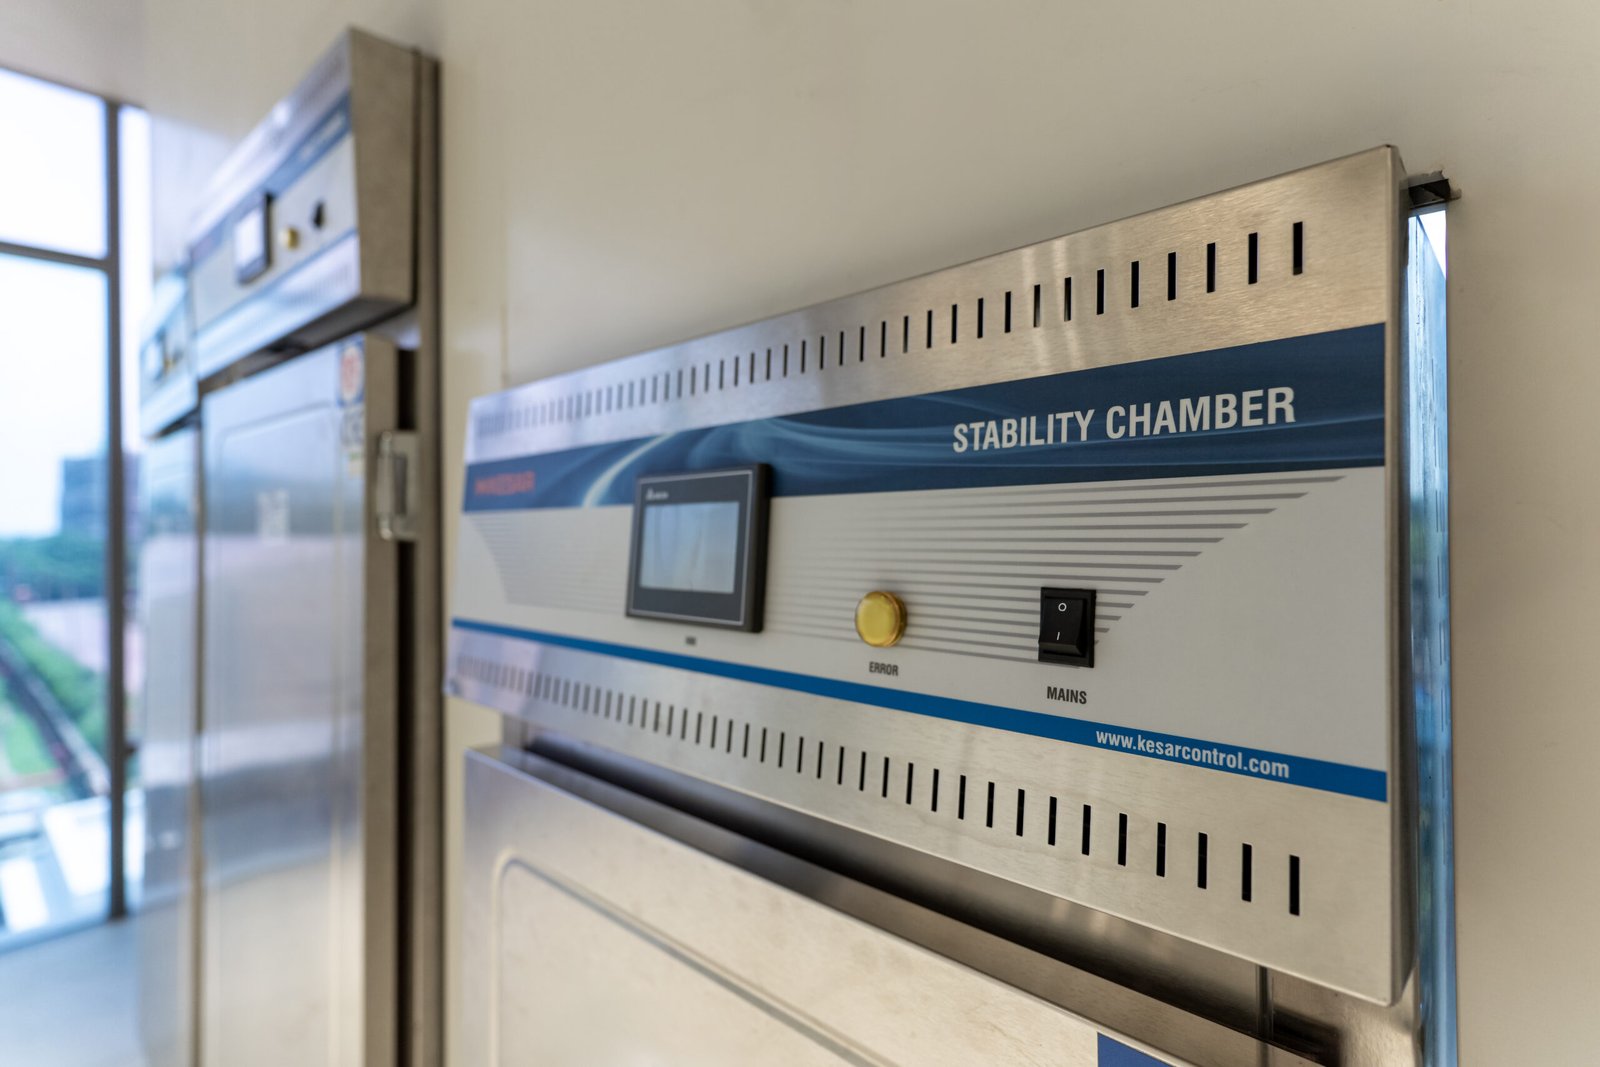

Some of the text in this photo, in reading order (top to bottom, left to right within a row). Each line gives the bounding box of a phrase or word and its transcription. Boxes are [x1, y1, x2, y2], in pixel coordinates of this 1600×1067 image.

[952, 386, 1296, 453] STABILITY CHAMBER
[869, 661, 899, 676] ERROR
[1046, 686, 1088, 705] MAINS
[1095, 730, 1290, 779] www.kesarcontrol.com
